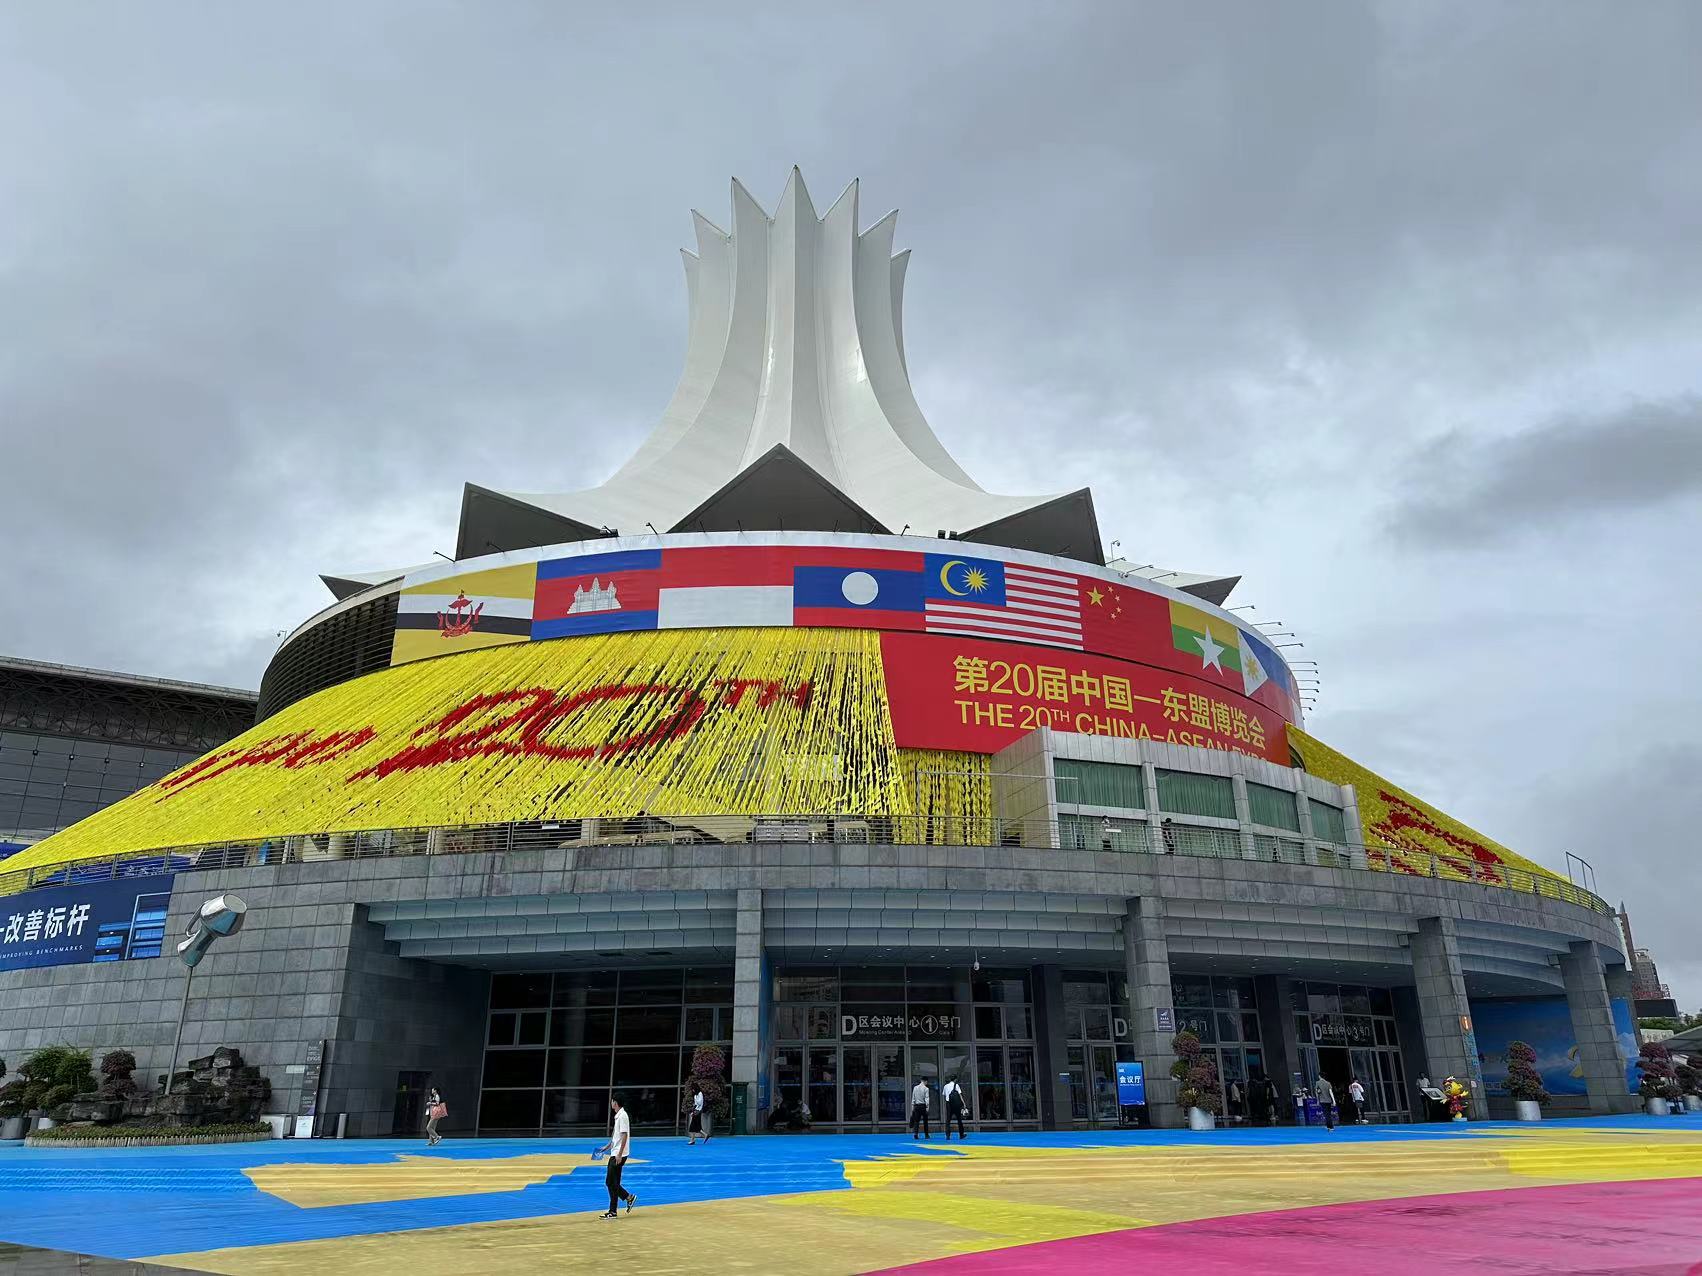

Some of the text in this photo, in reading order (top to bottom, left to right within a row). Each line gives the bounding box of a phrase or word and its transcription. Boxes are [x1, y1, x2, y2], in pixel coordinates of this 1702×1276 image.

[954, 700, 1015, 728] THE
[0, 904, 91, 944] 改善标杆
[36, 944, 83, 956] BENCHMARKS
[1119, 1075, 1141, 1084] 会议厅
